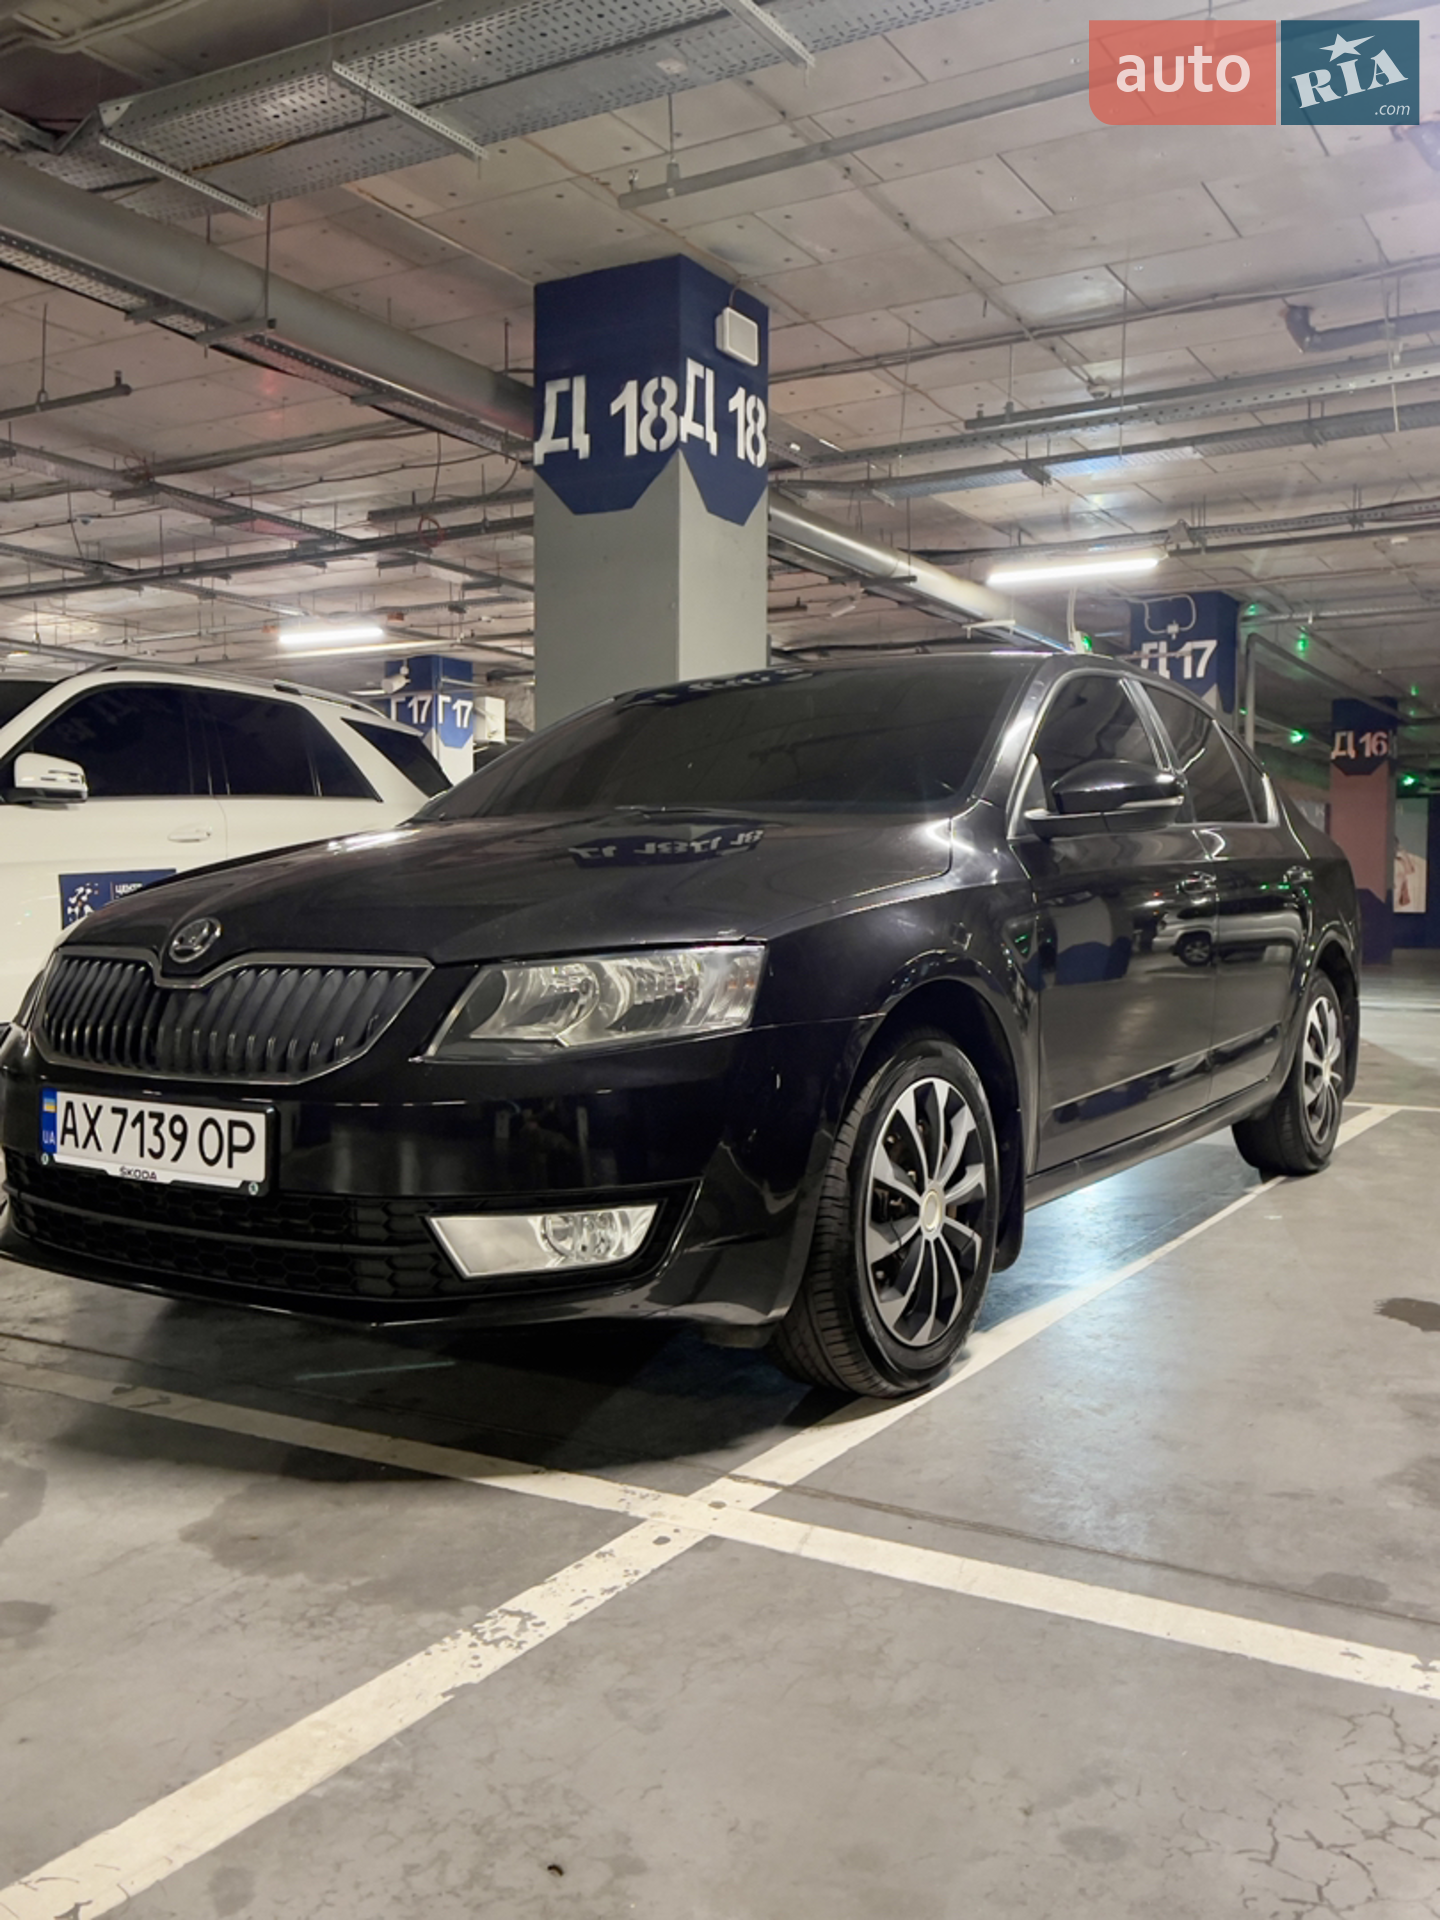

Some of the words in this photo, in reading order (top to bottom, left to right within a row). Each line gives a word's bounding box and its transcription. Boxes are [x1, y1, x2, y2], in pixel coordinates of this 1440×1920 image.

[533, 374, 590, 466] Д
[610, 376, 678, 457] 18
[679, 357, 718, 456] Д
[728, 386, 767, 468] 18
[1175, 639, 1217, 679] 17
[408, 694, 433, 724] 17
[452, 699, 474, 728] 17
[1330, 730, 1356, 760] Д
[1359, 731, 1388, 758] 16
[42, 1130, 56, 1146] UA
[60, 1100, 103, 1152] AX
[110, 1106, 189, 1163] 7139
[198, 1117, 255, 1169] OP
